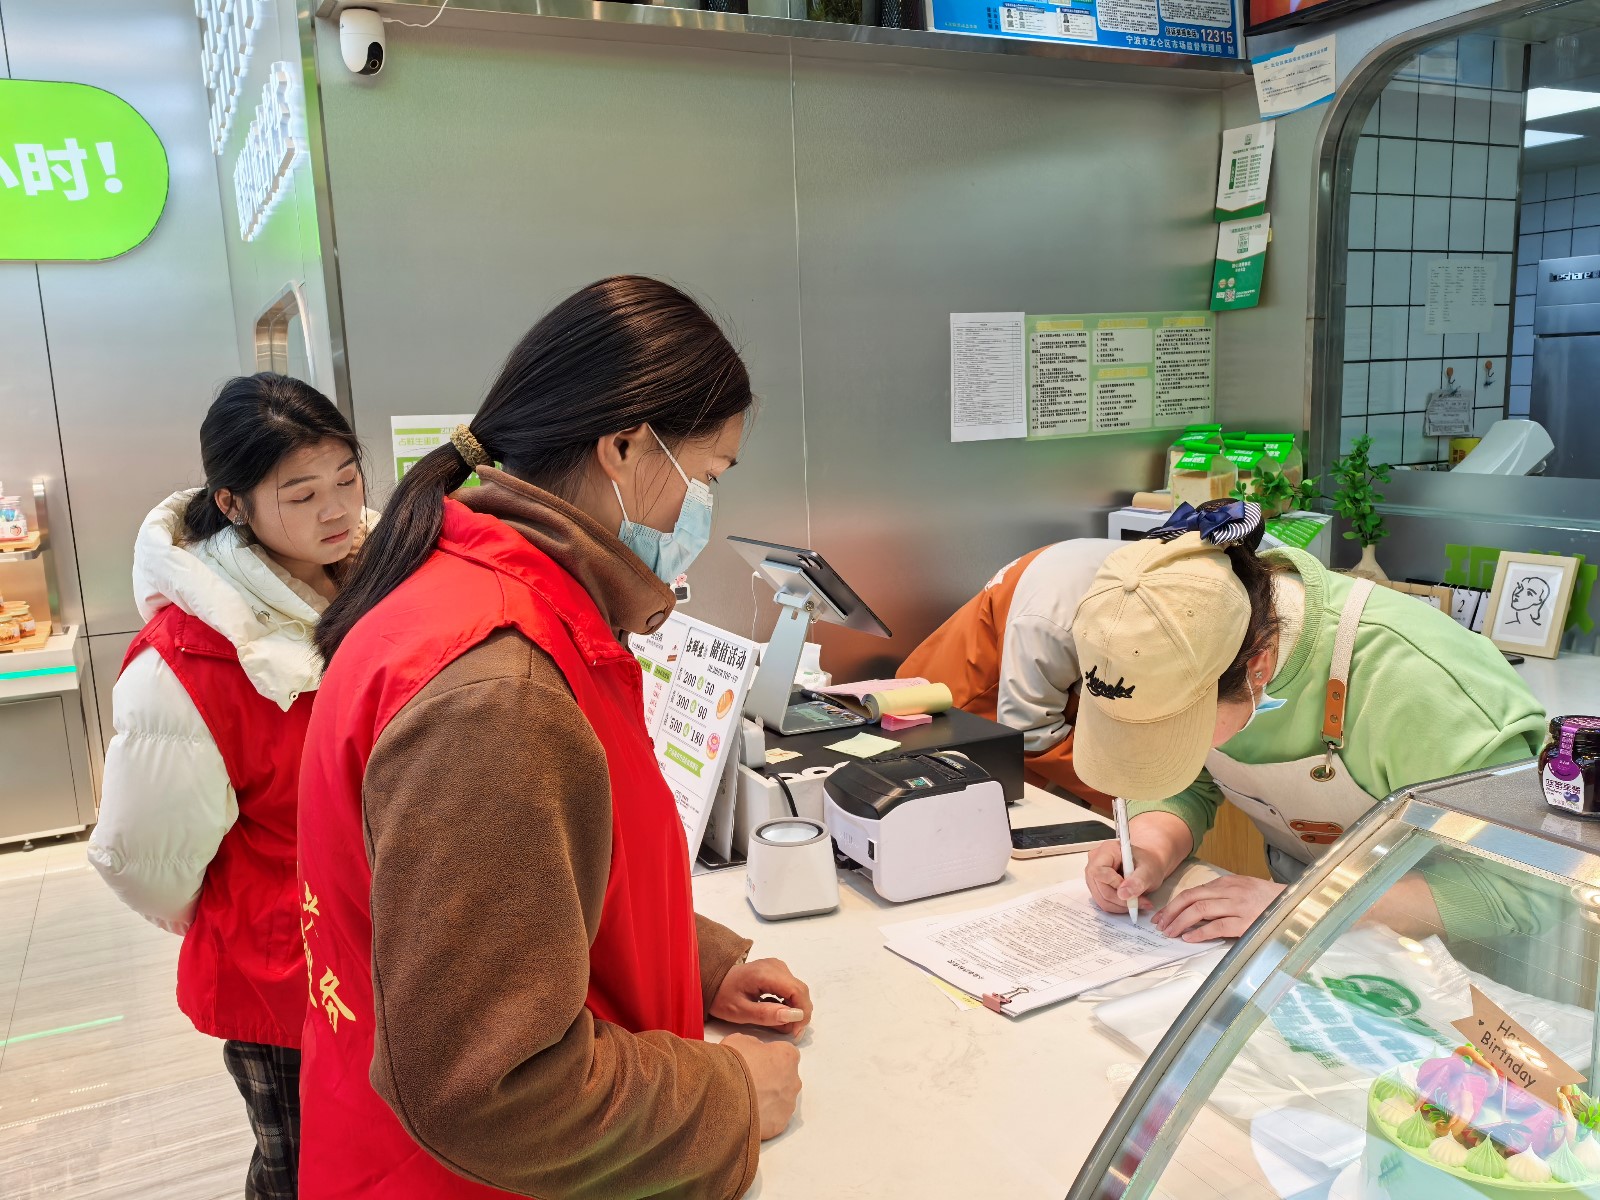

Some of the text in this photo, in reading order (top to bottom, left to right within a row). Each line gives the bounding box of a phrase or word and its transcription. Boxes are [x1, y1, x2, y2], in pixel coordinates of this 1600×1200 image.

[1126, 35, 1222, 54] 宁波市北仑区市场监督管理局
[1201, 29, 1233, 44] 12315
[0, 137, 124, 201] 时！
[683, 672, 697, 687] 200
[705, 681, 715, 696] 50
[676, 695, 690, 711] 300
[698, 705, 708, 720] 90
[669, 718, 683, 734] 500
[690, 729, 706, 746] 180
[1480, 1031, 1536, 1088] Birthday
